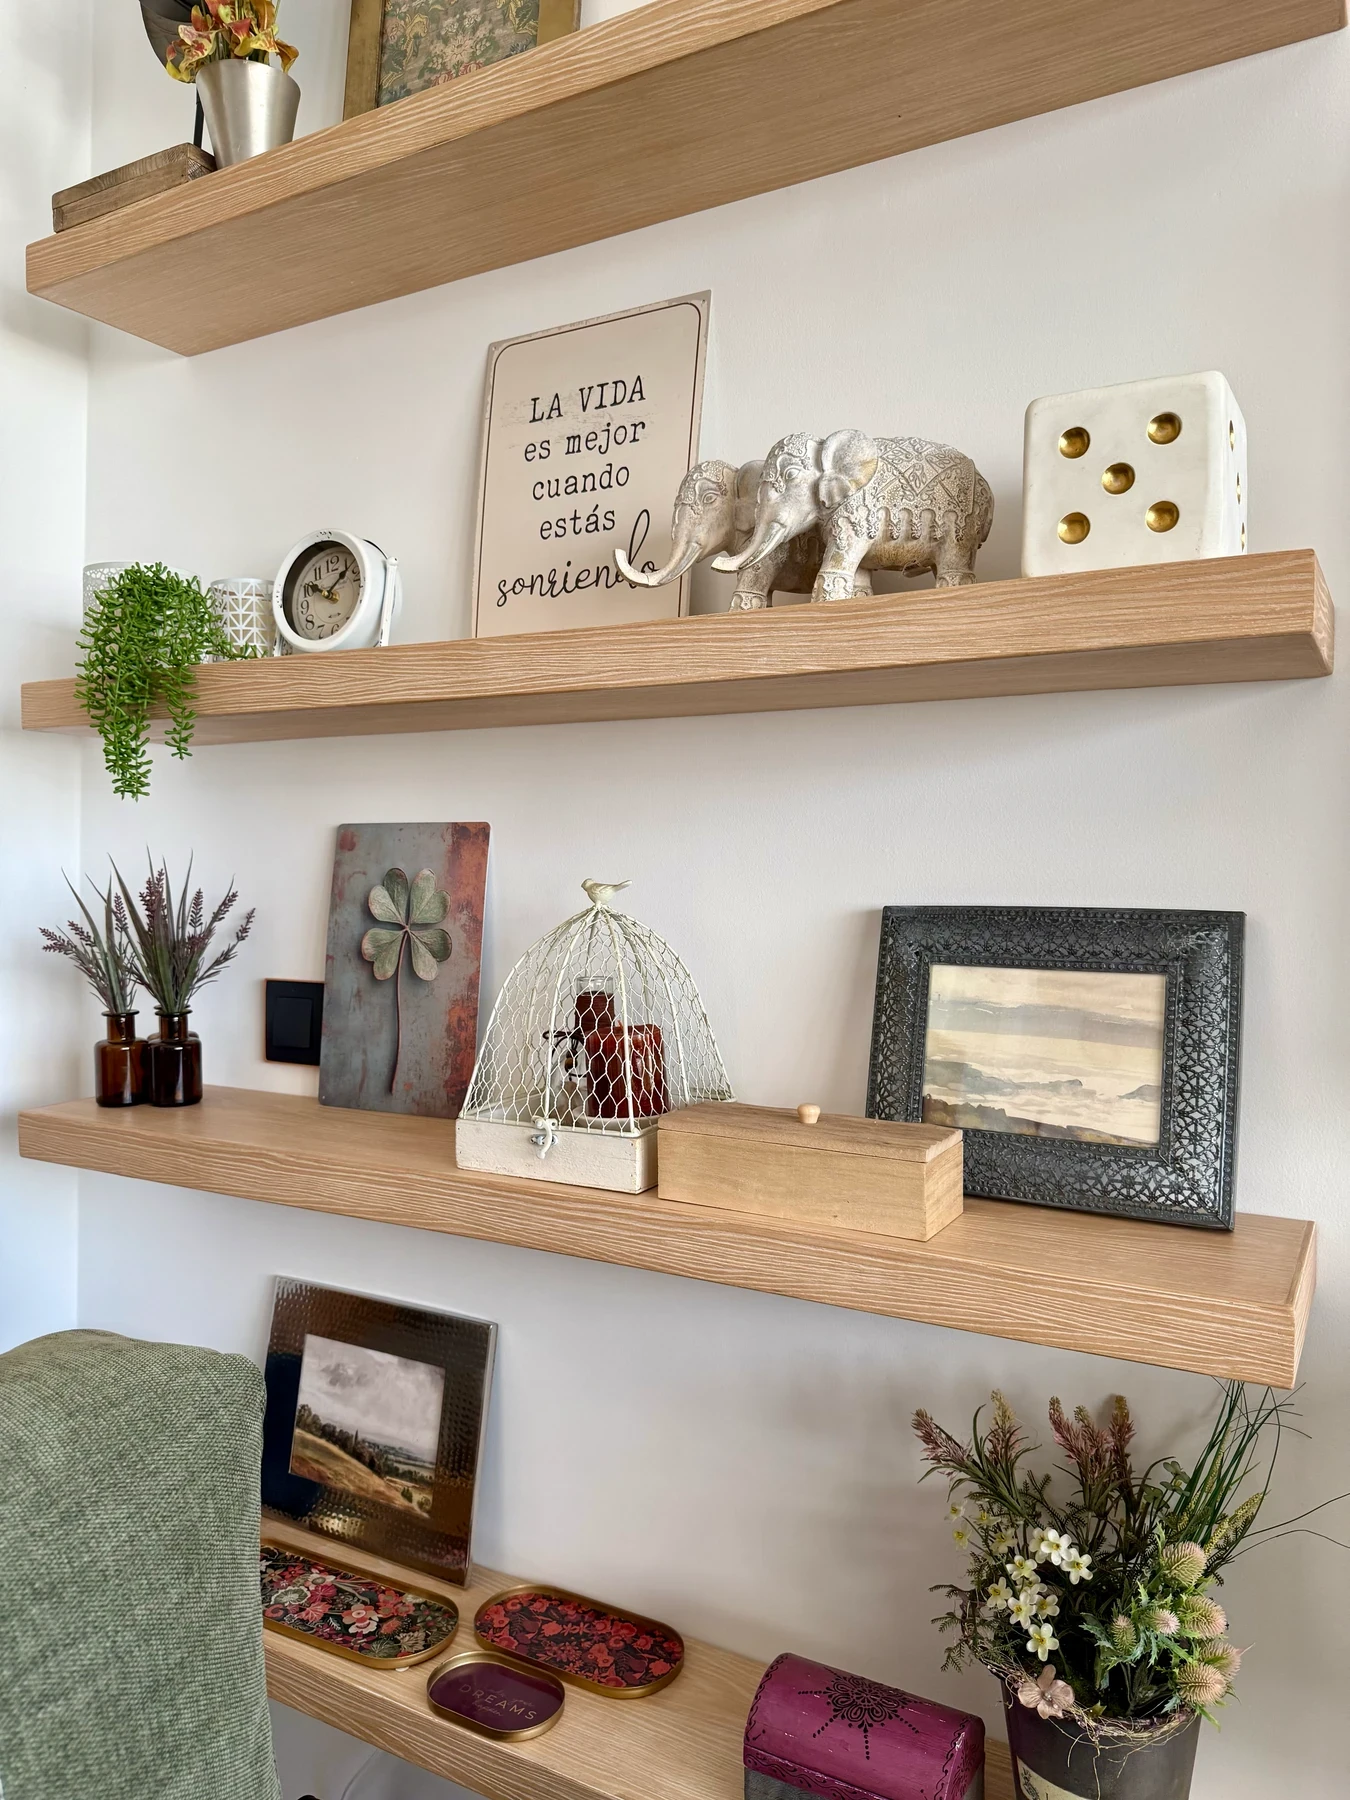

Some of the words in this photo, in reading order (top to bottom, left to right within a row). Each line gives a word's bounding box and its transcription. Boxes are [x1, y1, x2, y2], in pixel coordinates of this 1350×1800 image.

[528, 392, 563, 424] LA
[578, 375, 646, 413] VIDA
[524, 439, 551, 462] es
[565, 421, 646, 455] mejor
[532, 463, 630, 501] cuando
[540, 504, 616, 541] estás
[314, 566, 322, 581] 11
[325, 555, 340, 574] 12
[300, 599, 310, 615] 9
[305, 614, 315, 631] 8
[317, 624, 325, 639] 7
[459, 1683, 538, 1721] DREAMS
